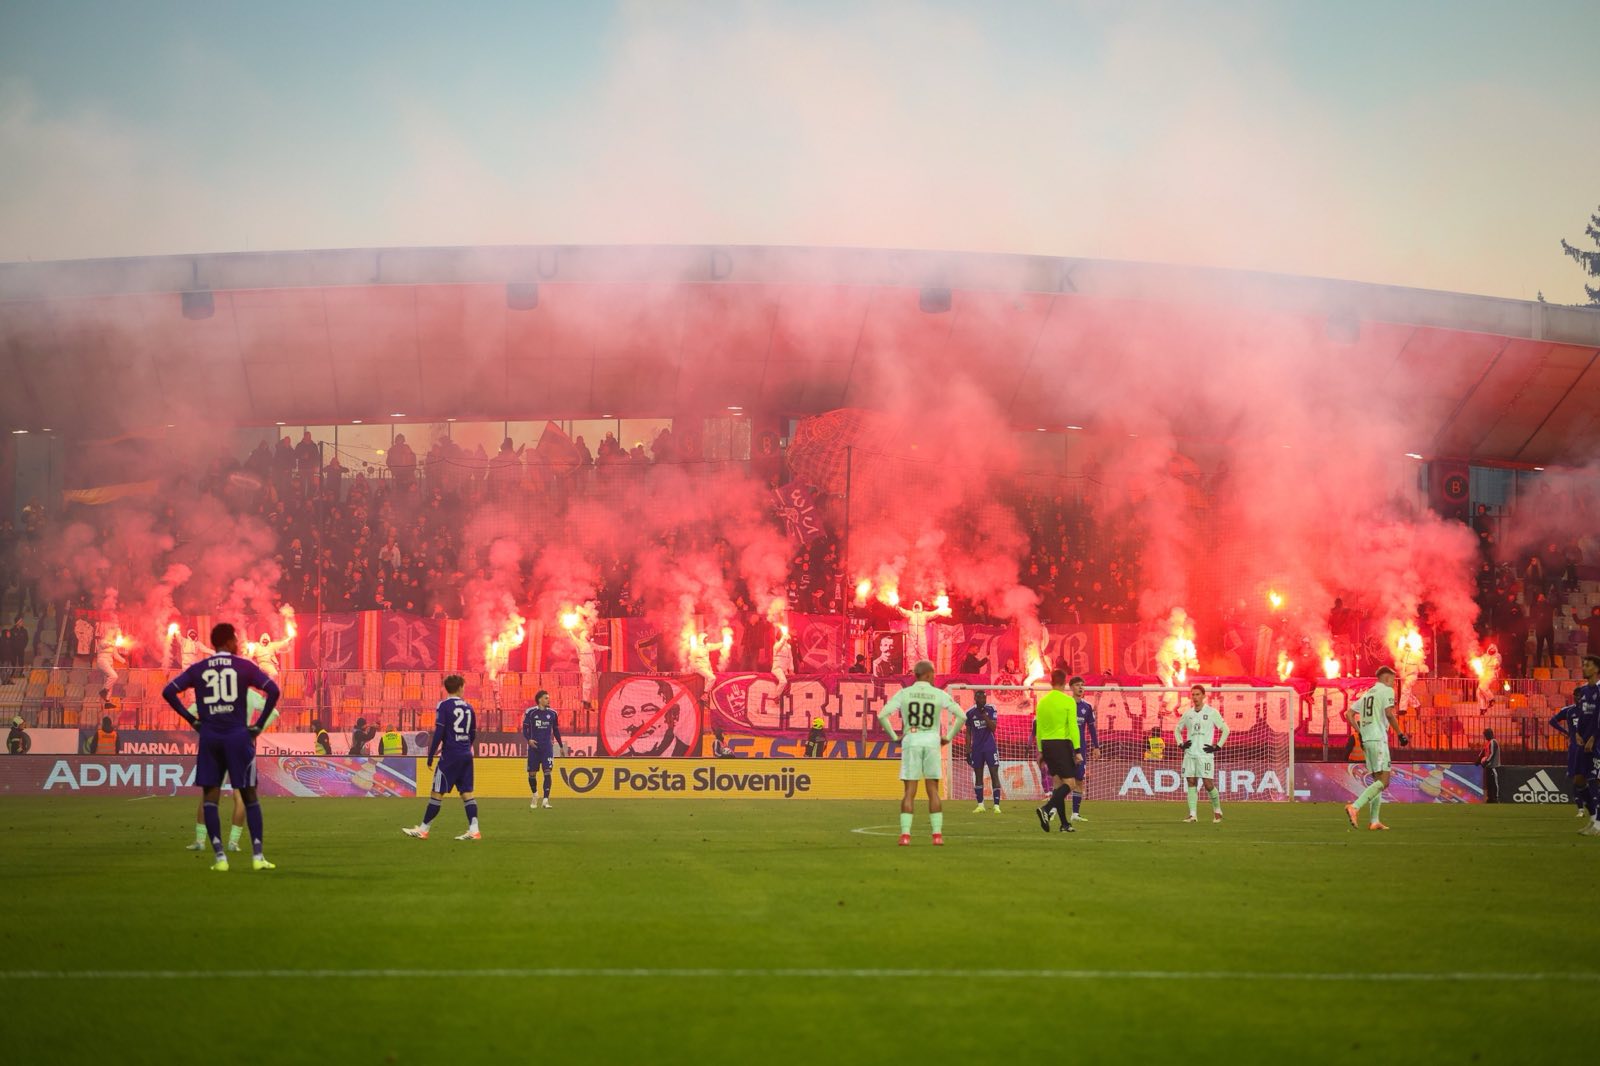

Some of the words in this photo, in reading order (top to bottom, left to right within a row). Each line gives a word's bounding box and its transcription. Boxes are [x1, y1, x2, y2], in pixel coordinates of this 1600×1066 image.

[201, 668, 238, 704] 30
[908, 701, 935, 728] 88
[1363, 695, 1374, 718] 19
[453, 707, 471, 734] 21
[117, 742, 180, 755] INARNA
[183, 743, 199, 755] M
[43, 760, 233, 790] ADMIR
[1204, 762, 1211, 771] 10
[614, 767, 686, 790] Pošta
[693, 766, 812, 797] Slovenije
[1119, 766, 1311, 796] ADIRAL
[1513, 790, 1569, 803] adidas
